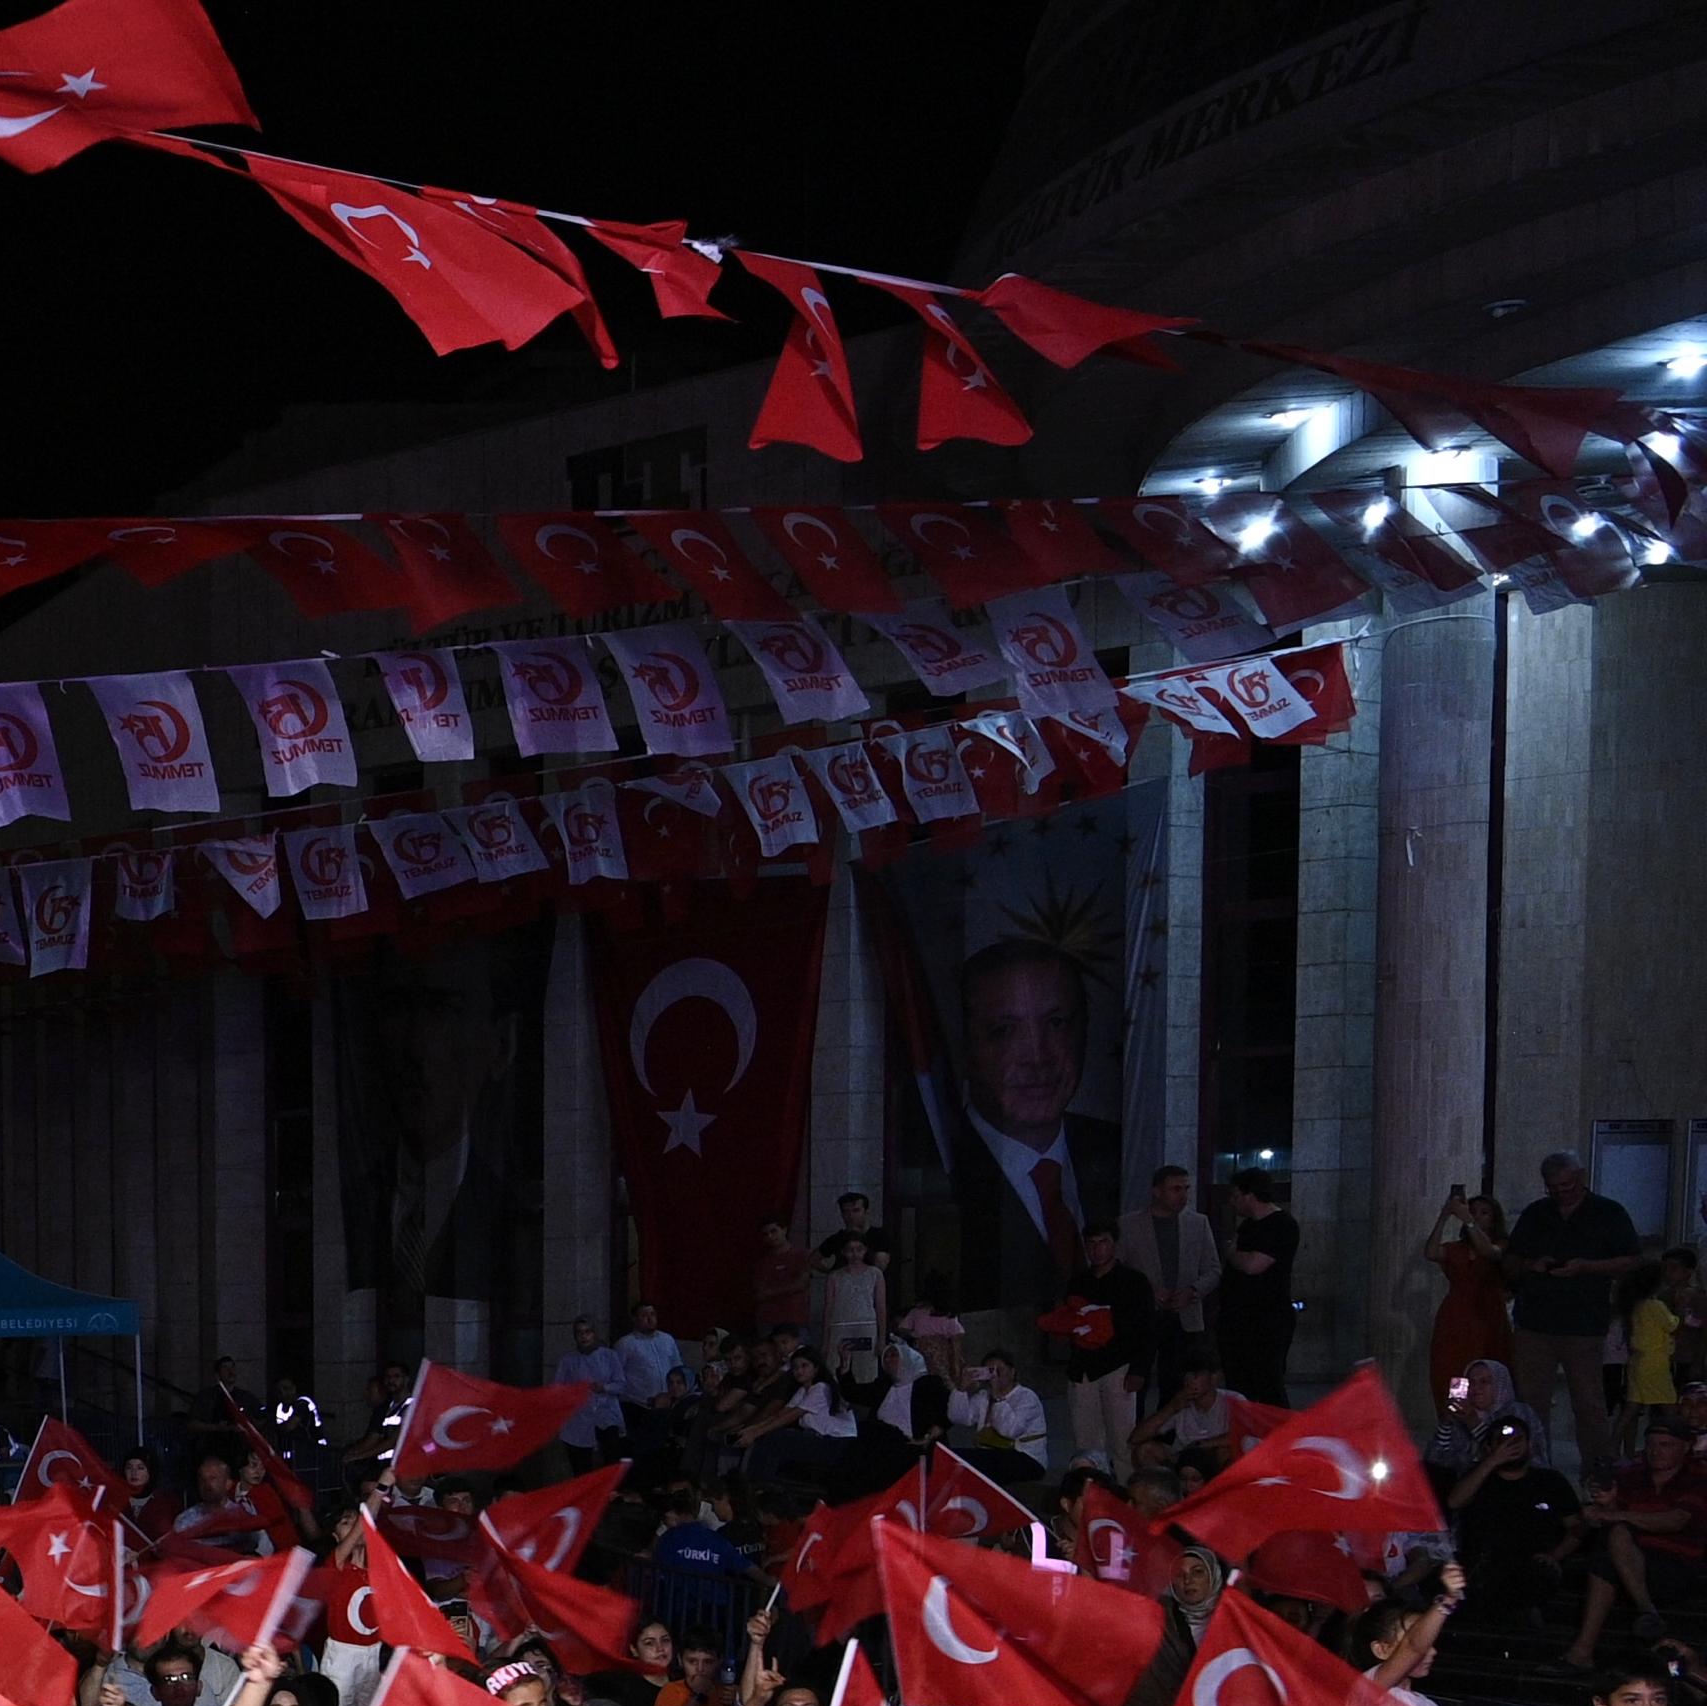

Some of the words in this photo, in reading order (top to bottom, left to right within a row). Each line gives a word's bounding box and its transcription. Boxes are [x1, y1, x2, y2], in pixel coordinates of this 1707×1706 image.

[1238, 674, 1269, 704] 15
[914, 783, 964, 801] TEMMUZ
[477, 843, 526, 862] TEMMUZ
[402, 856, 458, 881] TEMMUZ
[304, 885, 352, 901] TEMMUZ
[48, 896, 73, 932] 15
[0, 1317, 78, 1330] BELEDİYESİ
